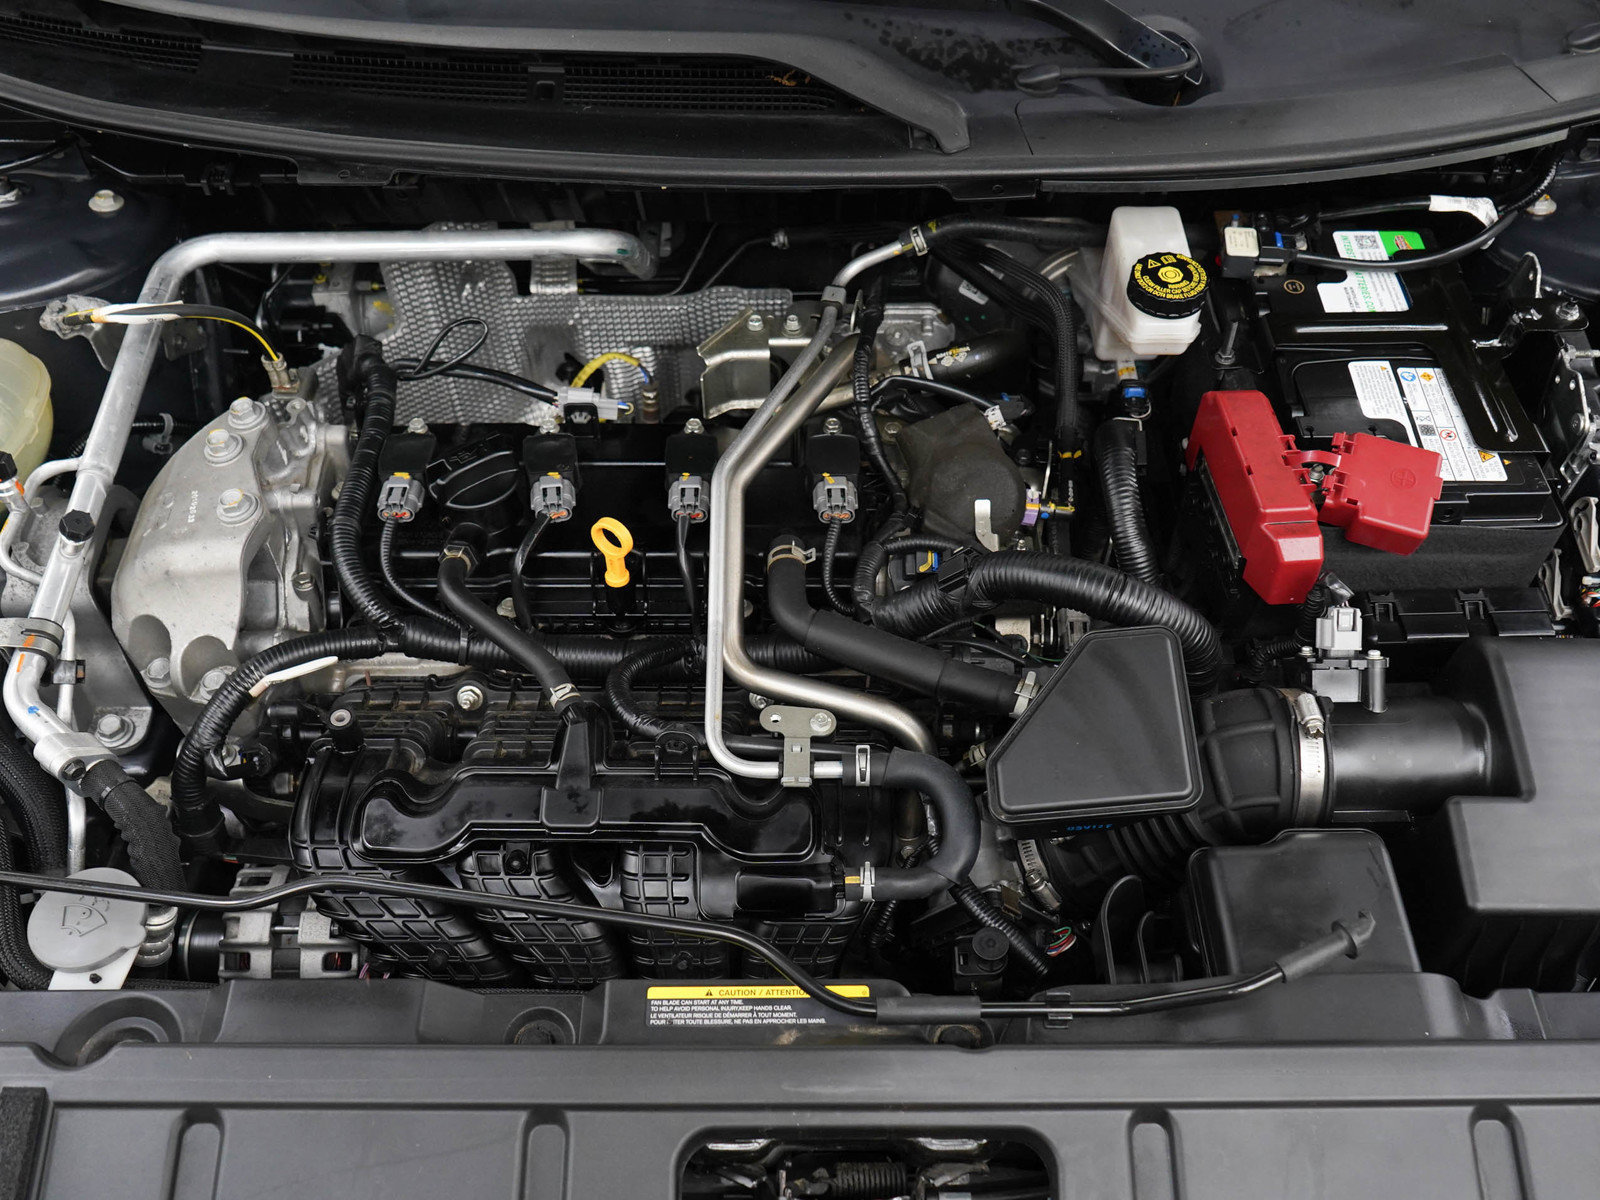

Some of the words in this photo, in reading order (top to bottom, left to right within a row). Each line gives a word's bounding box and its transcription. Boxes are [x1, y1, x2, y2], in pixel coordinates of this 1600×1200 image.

[1143, 276, 1155, 287] CLEAN
[1154, 285, 1170, 293] FILLER
[1182, 281, 1198, 292] BEFORE
